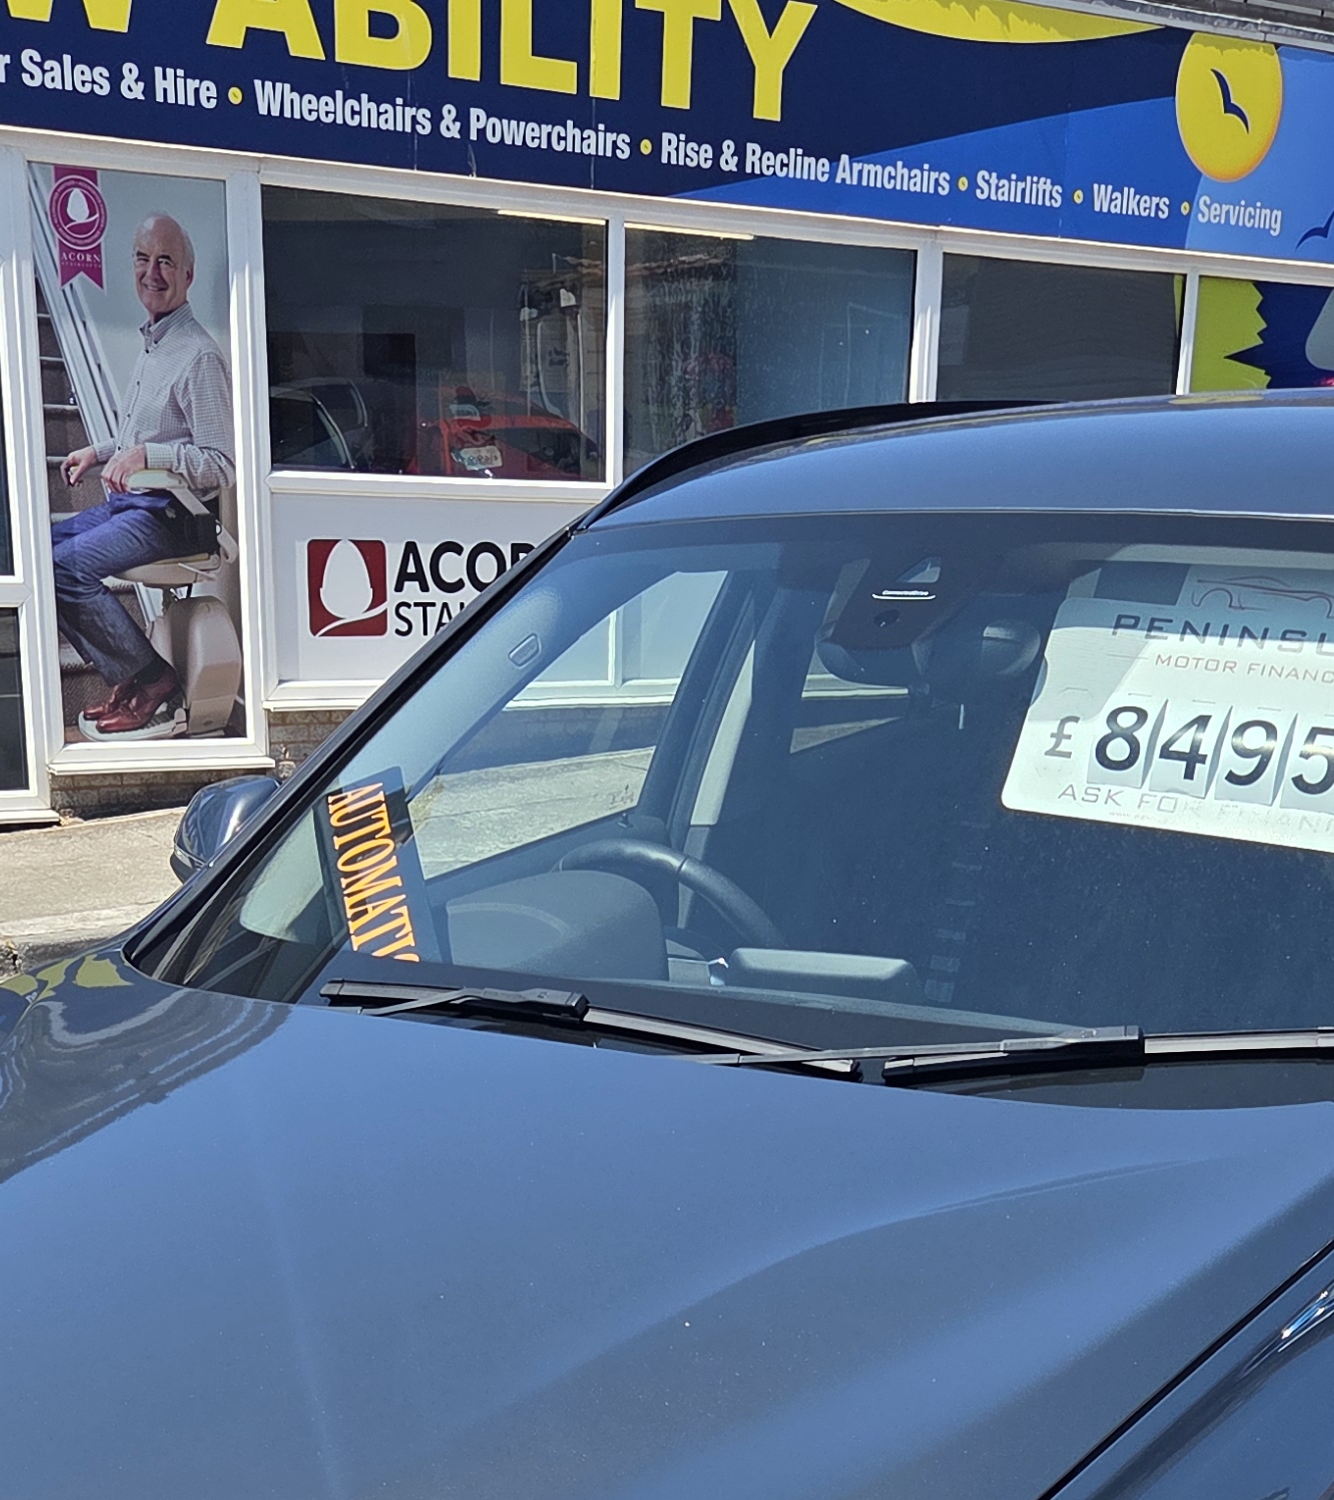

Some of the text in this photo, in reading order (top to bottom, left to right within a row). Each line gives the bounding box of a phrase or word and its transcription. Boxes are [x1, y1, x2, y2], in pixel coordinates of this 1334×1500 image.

[22, 48, 110, 96] Sales
[121, 62, 145, 100] &
[155, 66, 217, 109] Hire
[254, 79, 432, 136] Wheelchairs
[440, 104, 461, 140] &
[470, 107, 631, 160] Powerchairs
[661, 132, 713, 170] Rise
[720, 139, 738, 173] &
[745, 142, 830, 183] Recline
[835, 154, 950, 196] Armchairs
[975, 170, 1062, 208] Stairlifts
[1092, 183, 1169, 220] Walkers
[1197, 195, 1282, 236] Servicing
[62, 251, 101, 263] ACORN
[395, 601, 465, 637] STA
[1154, 653, 1237, 675] MOTOR
[1058, 783, 1124, 808] ASK
[328, 782, 420, 962] AUTOMATI
